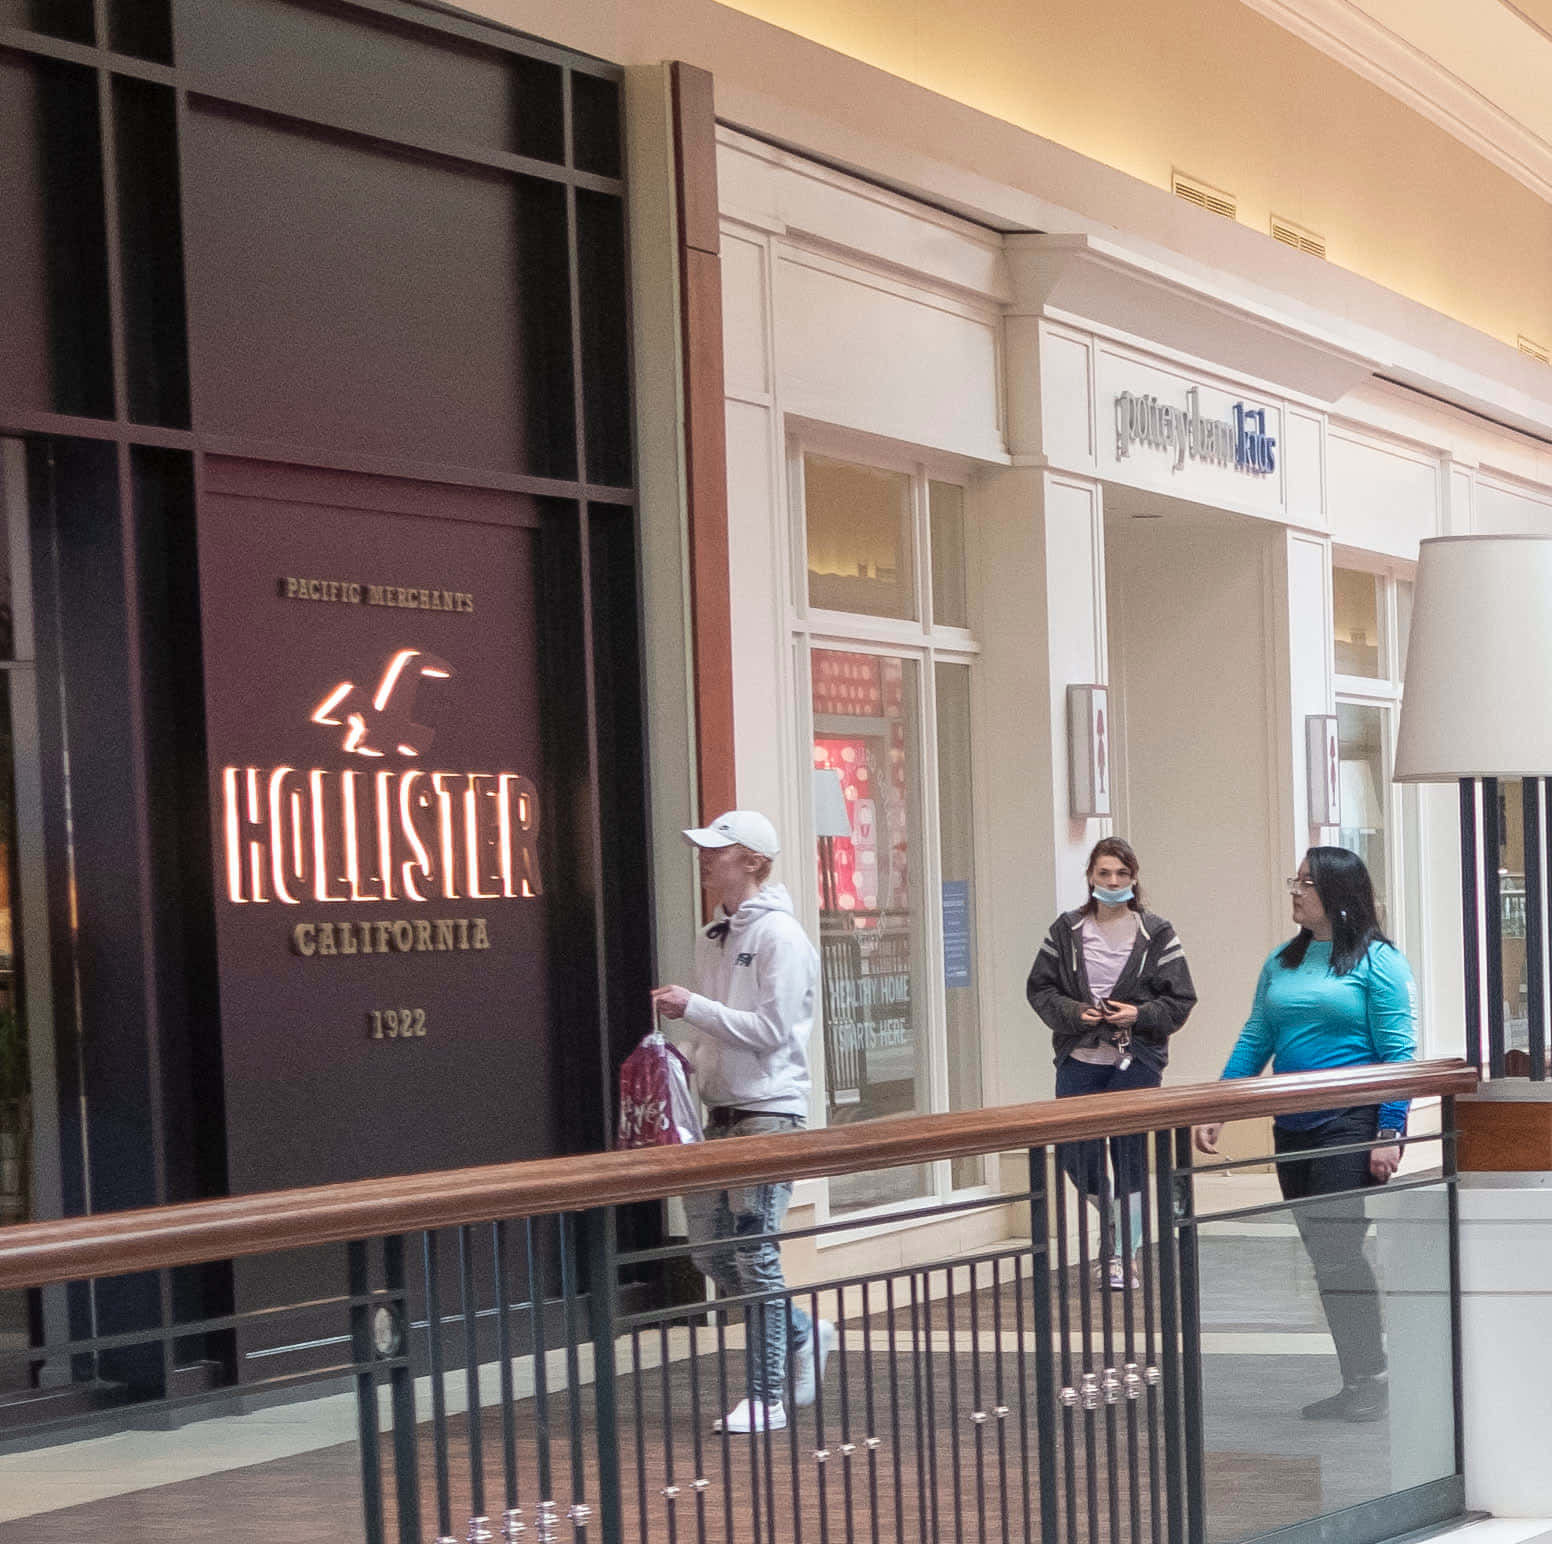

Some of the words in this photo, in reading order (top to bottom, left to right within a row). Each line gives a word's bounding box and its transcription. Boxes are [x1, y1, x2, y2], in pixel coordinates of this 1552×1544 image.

[287, 576, 361, 604] PACIFIC
[367, 584, 475, 613] MERCHANTS
[223, 766, 544, 904] HOLLISTER
[293, 918, 491, 957] CALIFORNIA
[370, 1008, 428, 1040] 1922
